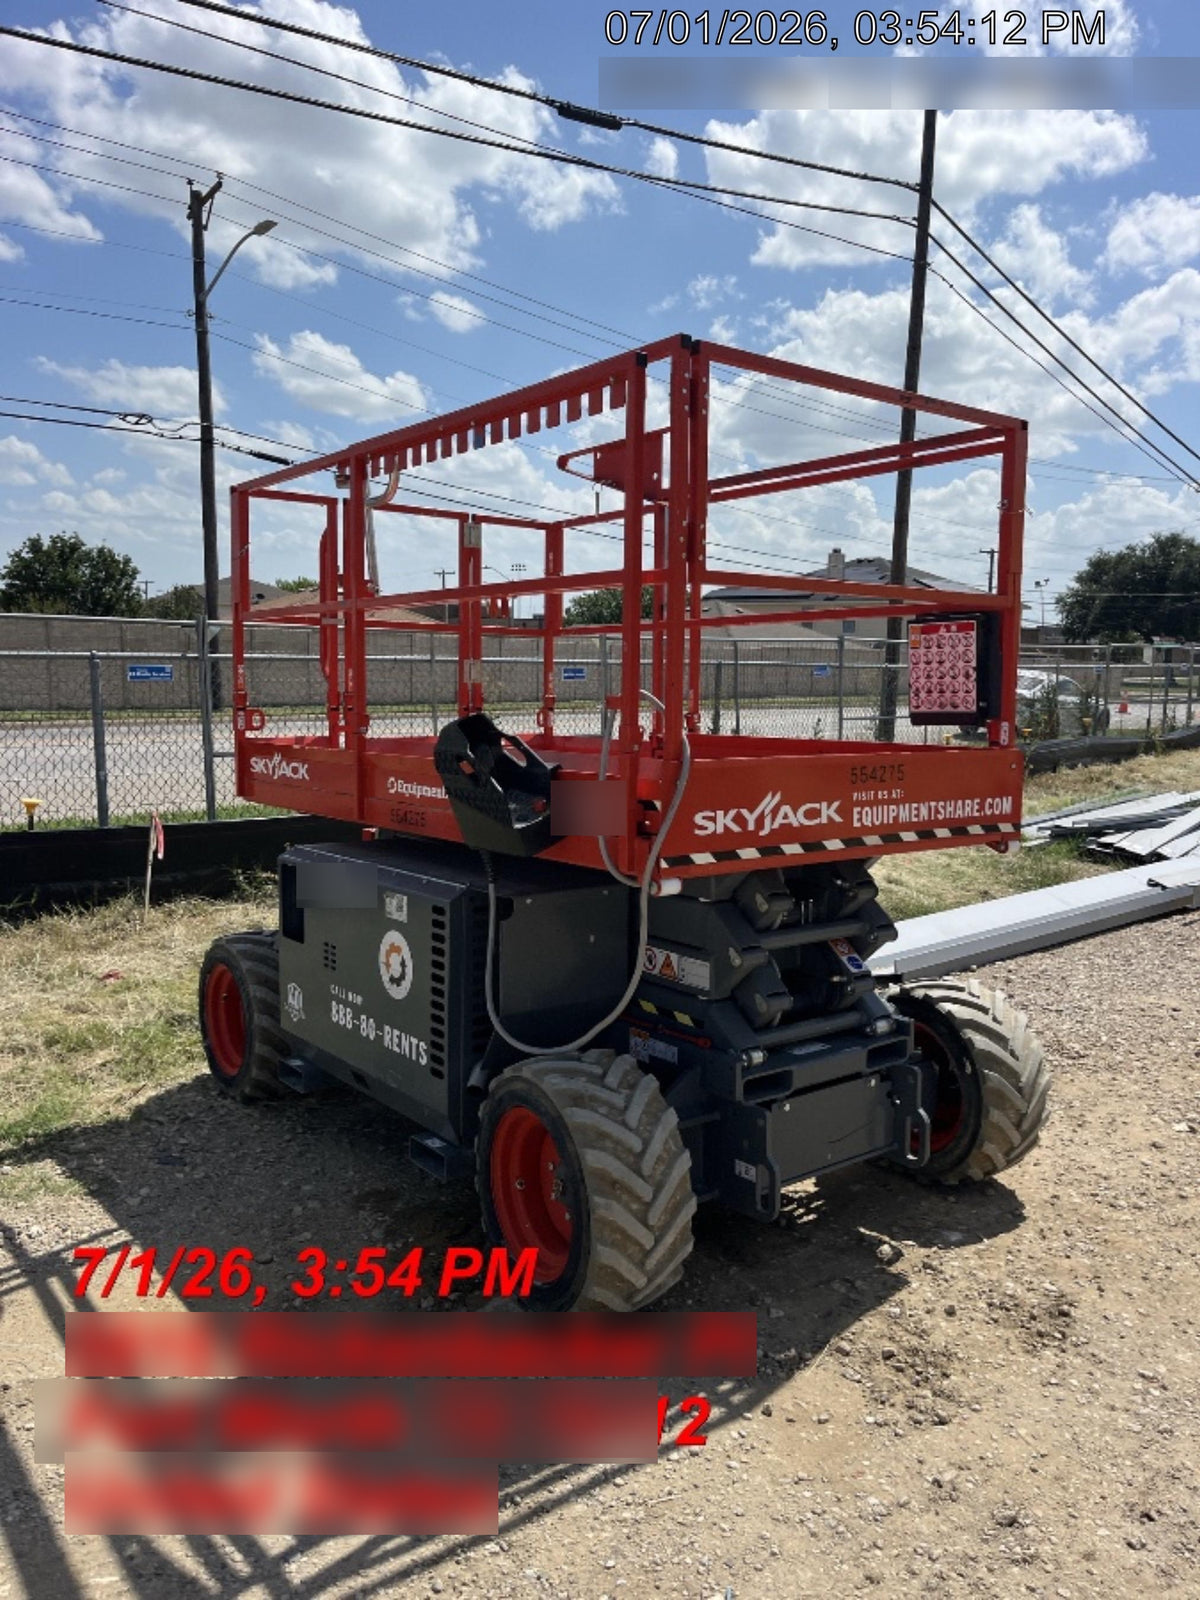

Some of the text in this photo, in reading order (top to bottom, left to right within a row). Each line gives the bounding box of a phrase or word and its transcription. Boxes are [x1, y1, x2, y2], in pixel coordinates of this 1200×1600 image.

[249, 752, 310, 780] SKYJACK
[850, 764, 905, 785] 554275
[397, 779, 449, 799] Equipment
[852, 788, 905, 802] VISIT US AT:
[693, 790, 844, 836] SKYJACK
[852, 796, 1013, 828] EQUIPMENTSHARE.COM
[329, 984, 364, 1006] CALL NOW
[331, 1000, 428, 1066] 888-80-RENTS
